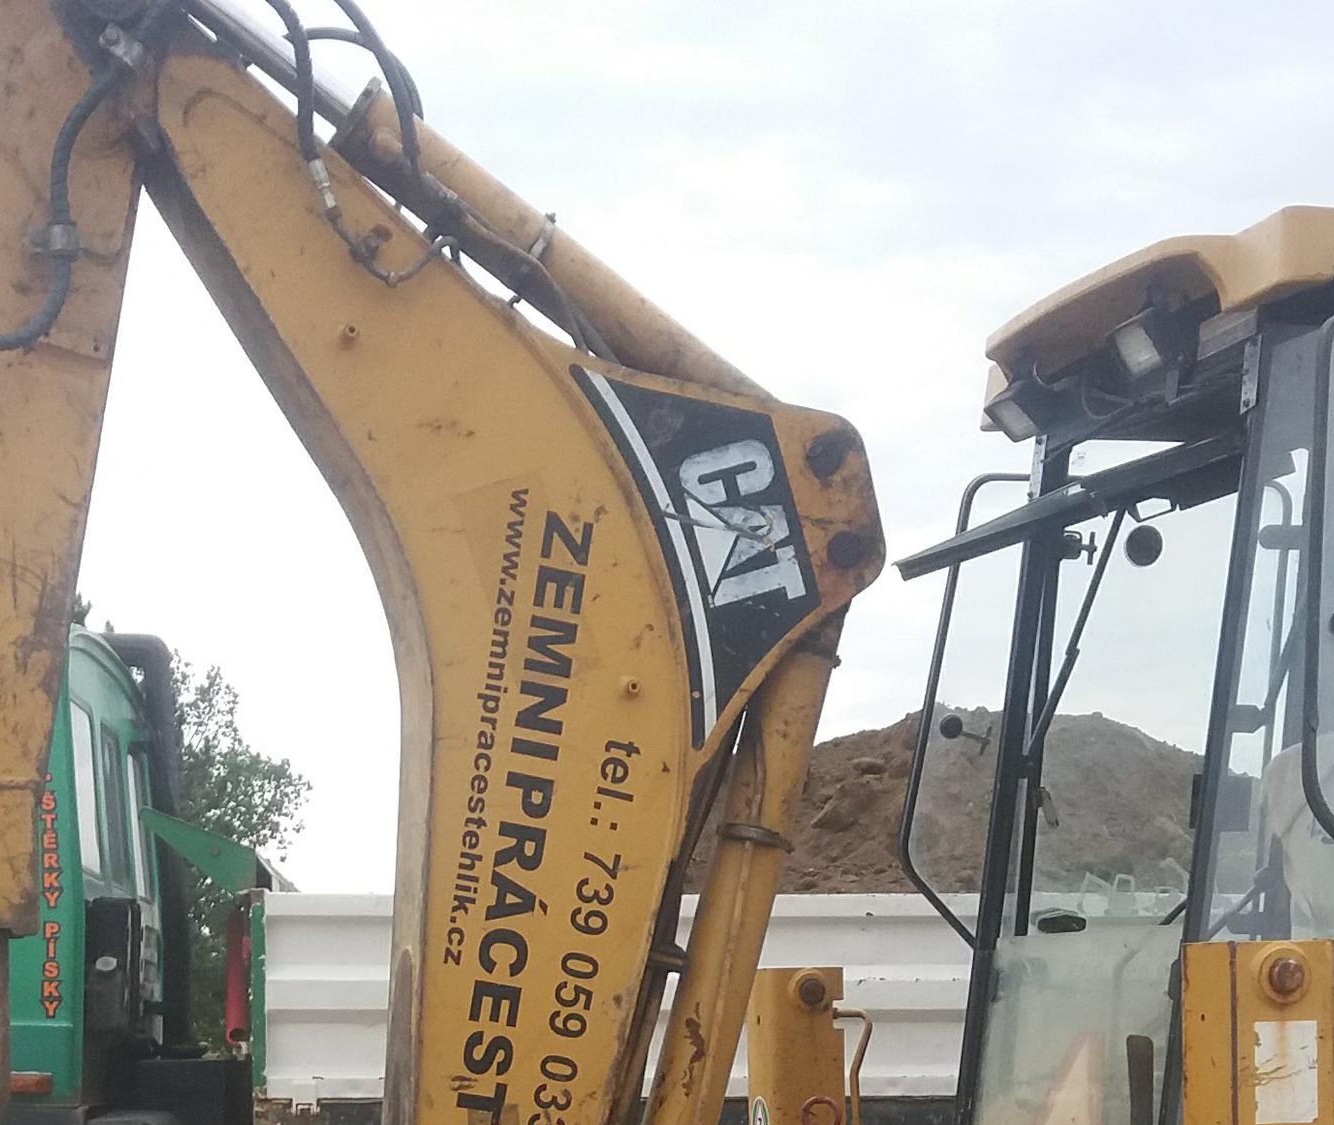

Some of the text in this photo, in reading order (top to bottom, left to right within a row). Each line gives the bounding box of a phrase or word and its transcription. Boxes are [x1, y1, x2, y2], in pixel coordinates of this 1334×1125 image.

[679, 438, 807, 607] CAT
[443, 488, 529, 966] www.zemnipracestehlik.cz
[590, 738, 642, 831] tel.:
[570, 851, 622, 936] 739
[41, 922, 64, 1019] PÍSKY
[549, 951, 599, 1039] 059
